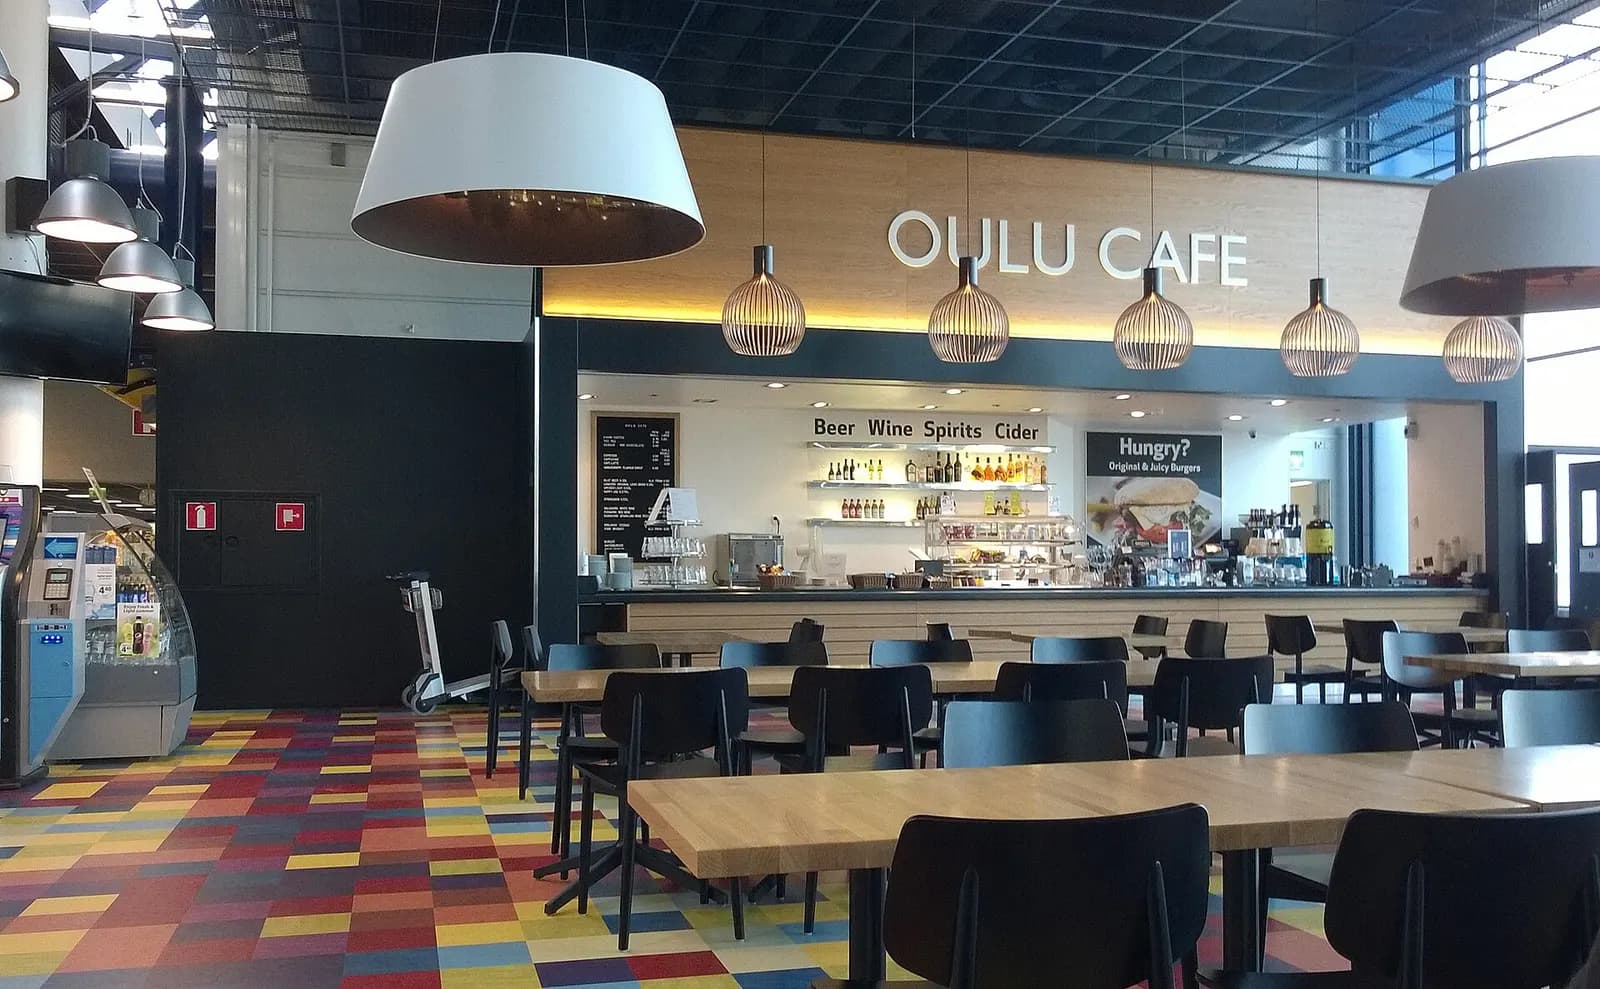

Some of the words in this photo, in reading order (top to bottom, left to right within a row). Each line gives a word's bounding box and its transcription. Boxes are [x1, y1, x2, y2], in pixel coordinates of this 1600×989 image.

[887, 210, 1075, 276] OULU
[1098, 227, 1248, 287] CAFE
[814, 418, 855, 436] Beer
[868, 418, 913, 437] Wine
[924, 420, 982, 442] Spirits
[995, 422, 1039, 440] Cider
[1119, 437, 1191, 461] Hungry?
[1108, 461, 1141, 472] Original
[1141, 462, 1149, 471] &
[1150, 462, 1170, 474] Juicy
[1170, 463, 1201, 474] Burgers
